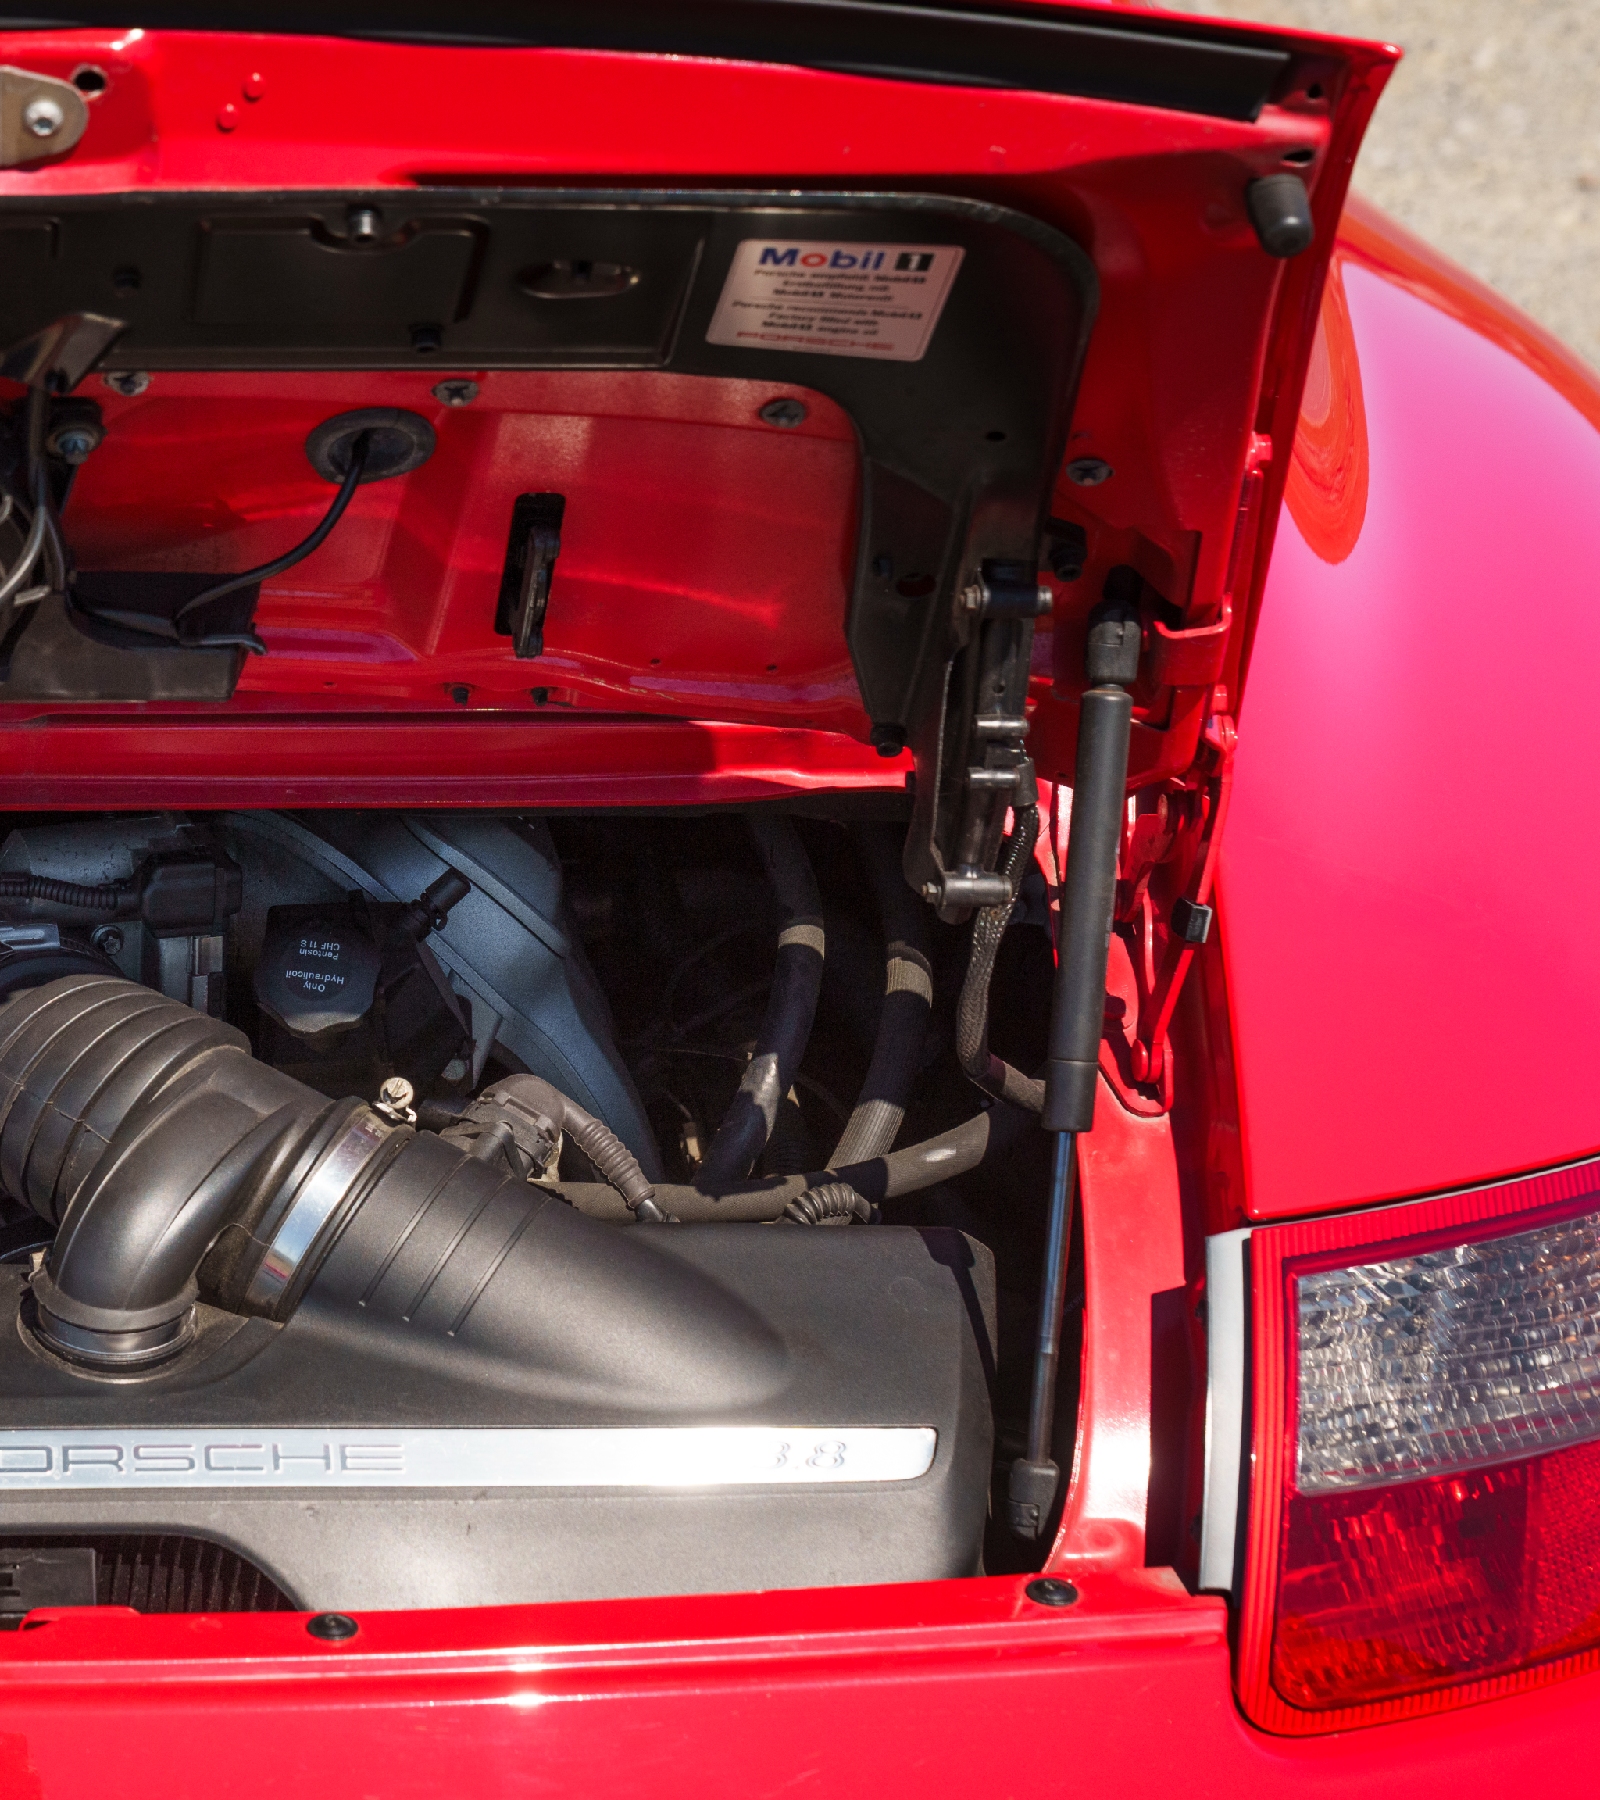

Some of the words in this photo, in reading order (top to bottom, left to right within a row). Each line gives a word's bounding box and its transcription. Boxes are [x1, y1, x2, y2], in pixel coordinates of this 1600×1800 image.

[759, 247, 885, 270] Mobil
[321, 942, 340, 950] CHF
[299, 948, 339, 961] Pentosin
[303, 980, 325, 993] Only
